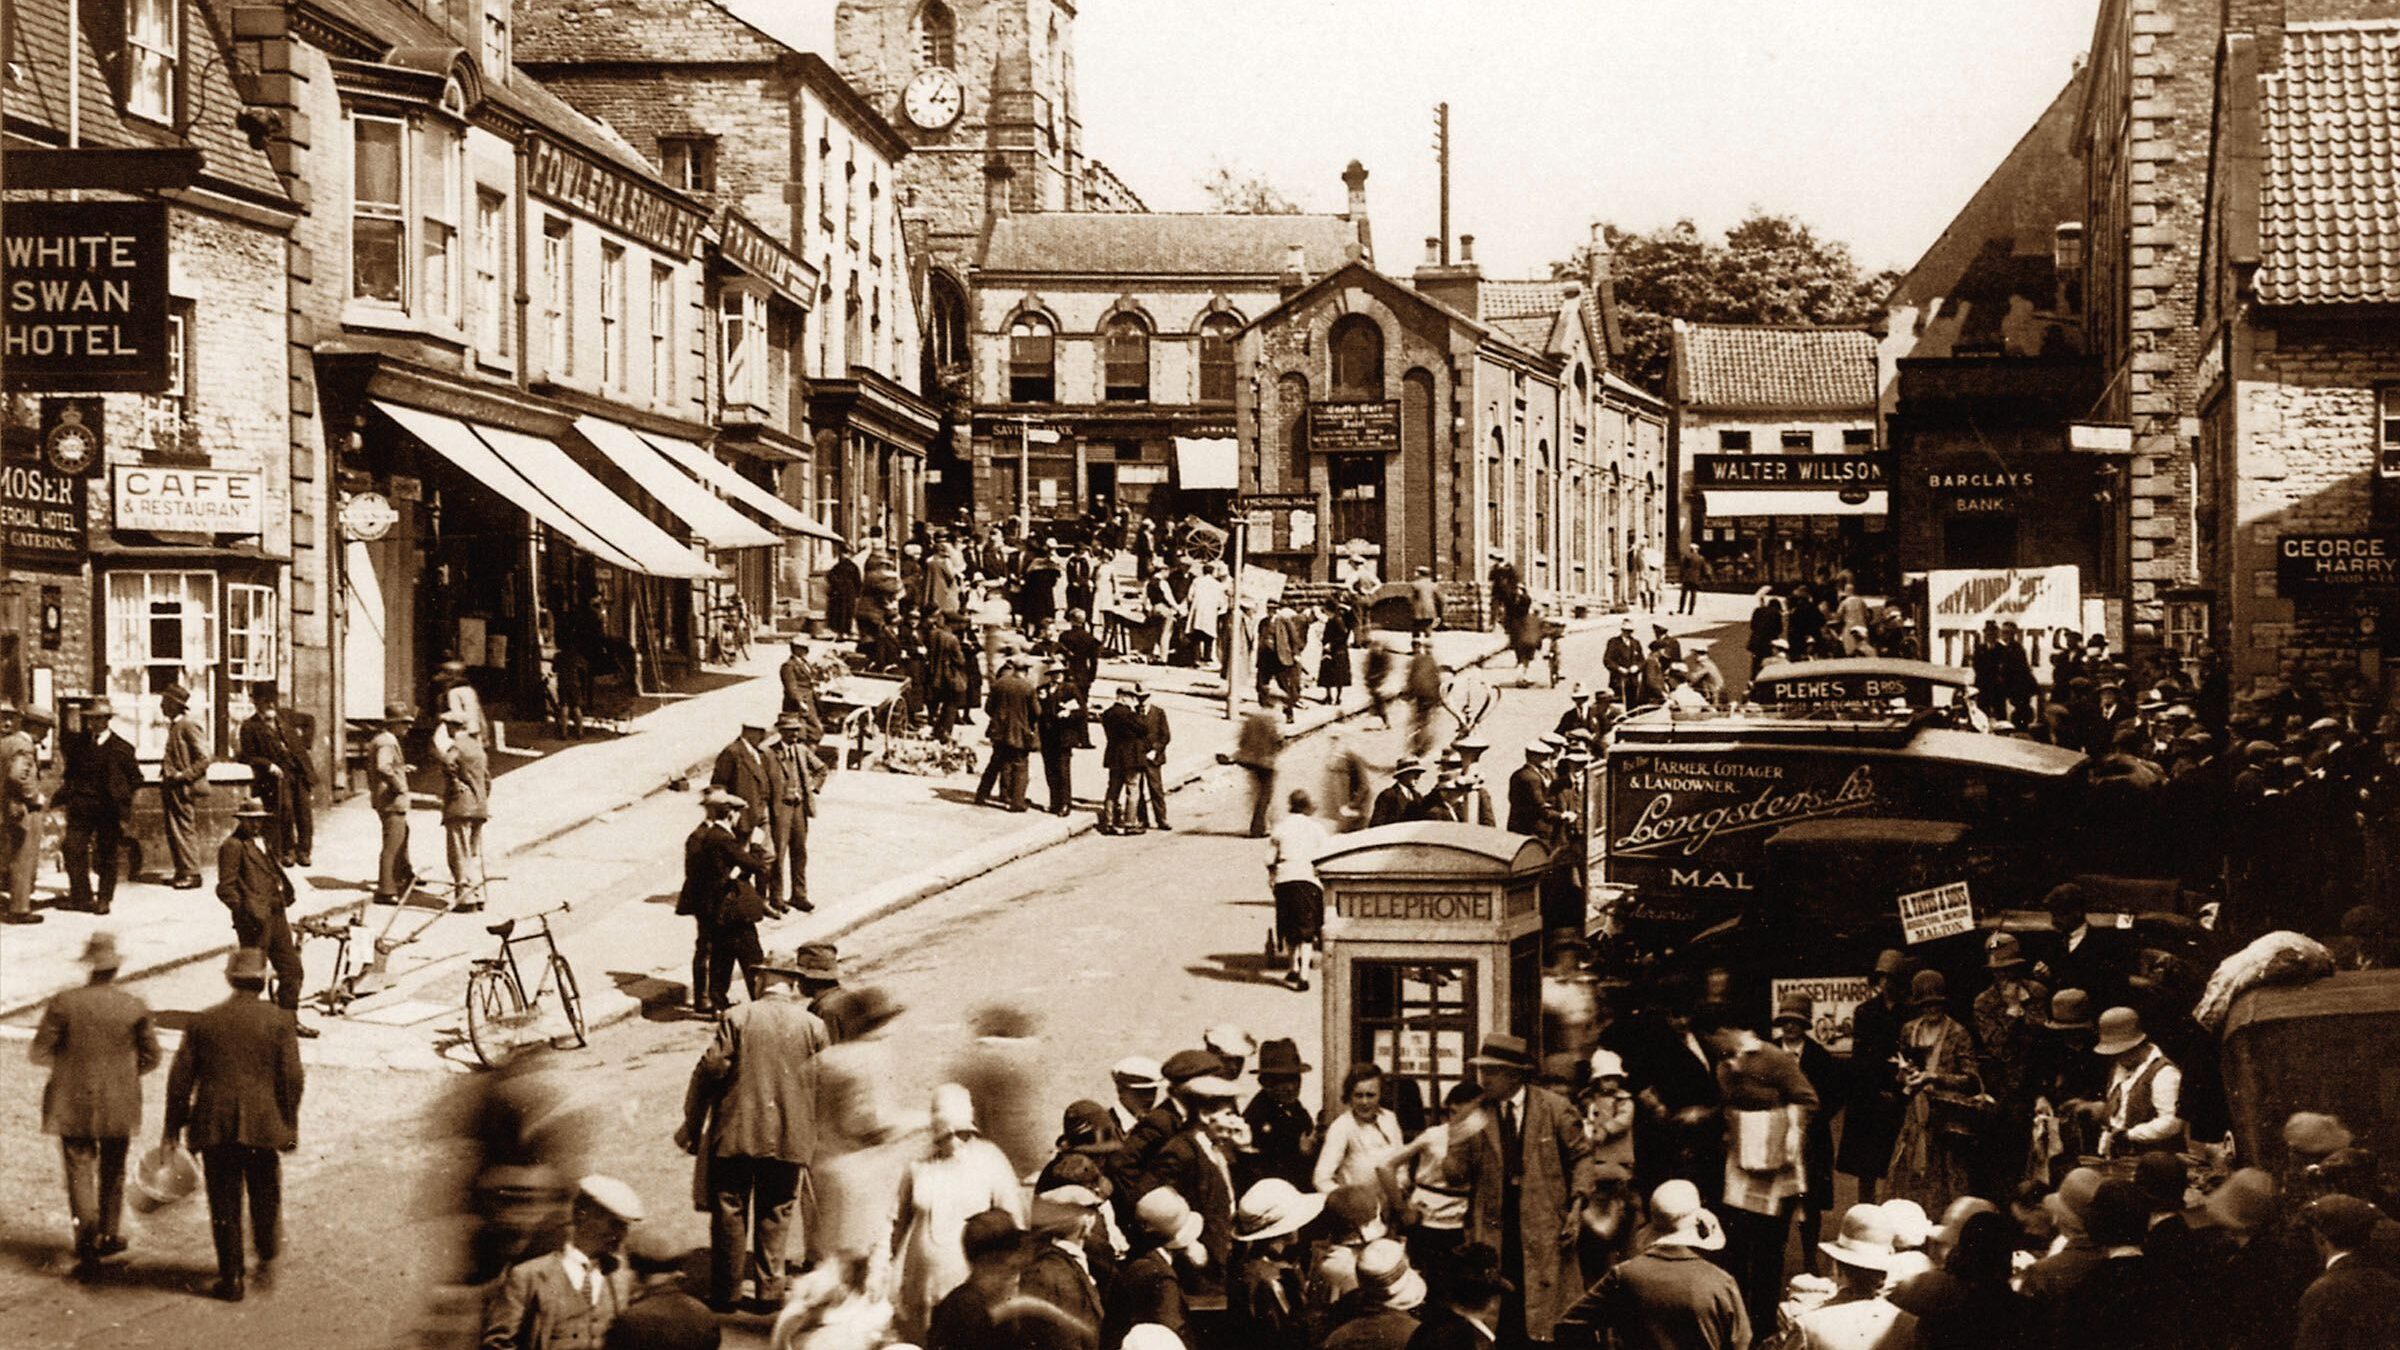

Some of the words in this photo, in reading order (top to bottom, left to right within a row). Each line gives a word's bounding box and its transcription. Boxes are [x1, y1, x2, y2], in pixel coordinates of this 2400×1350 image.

[532, 138, 613, 220] FOWLER
[5, 236, 136, 267] WHITE
[11, 280, 130, 312] SWAN
[5, 325, 137, 356] HOTEL
[1713, 462, 1788, 480] WALTER
[1799, 462, 1881, 481] WILLSON
[1929, 473, 2034, 487] BARCLAYS
[126, 473, 250, 499] CAFE
[123, 502, 134, 515] &
[141, 500, 250, 516] RESTAURANT
[1956, 498, 2004, 512] BANK
[2284, 539, 2385, 557] GEORGE
[2316, 559, 2397, 572] HARRY
[1775, 681, 1846, 699] PLEWES
[1714, 760, 1784, 779] COTTAGER
[1630, 775, 1640, 789] &
[1344, 894, 1486, 921] TELEPHONE
